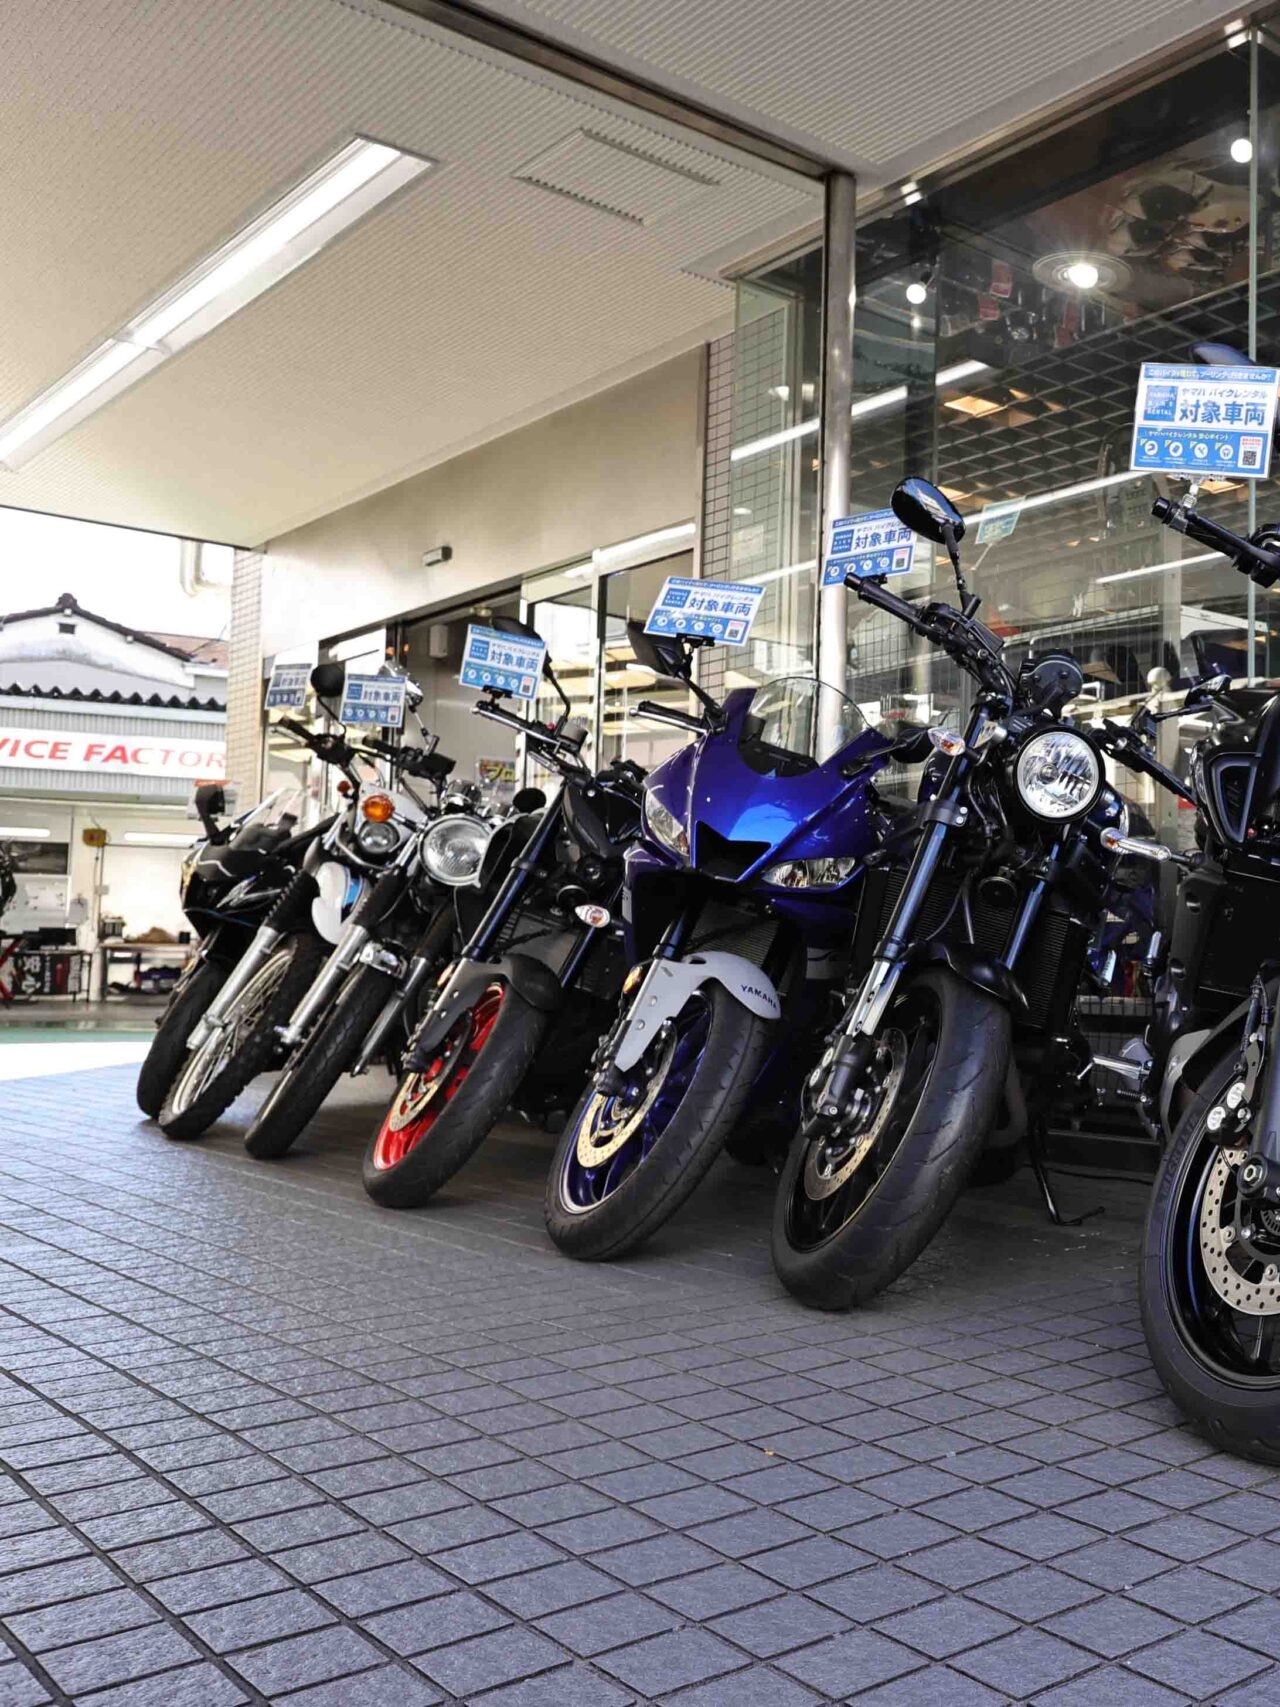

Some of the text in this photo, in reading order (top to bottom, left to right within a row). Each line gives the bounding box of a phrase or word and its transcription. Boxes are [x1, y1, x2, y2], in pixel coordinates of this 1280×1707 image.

[1181, 386, 1268, 399] ヤマハ バイクレンタル
[1179, 399, 1267, 426] 対象車両
[855, 527, 911, 550] 対象車両
[688, 598, 752, 616] 対象車両
[741, 984, 777, 1009] YAMAHA
